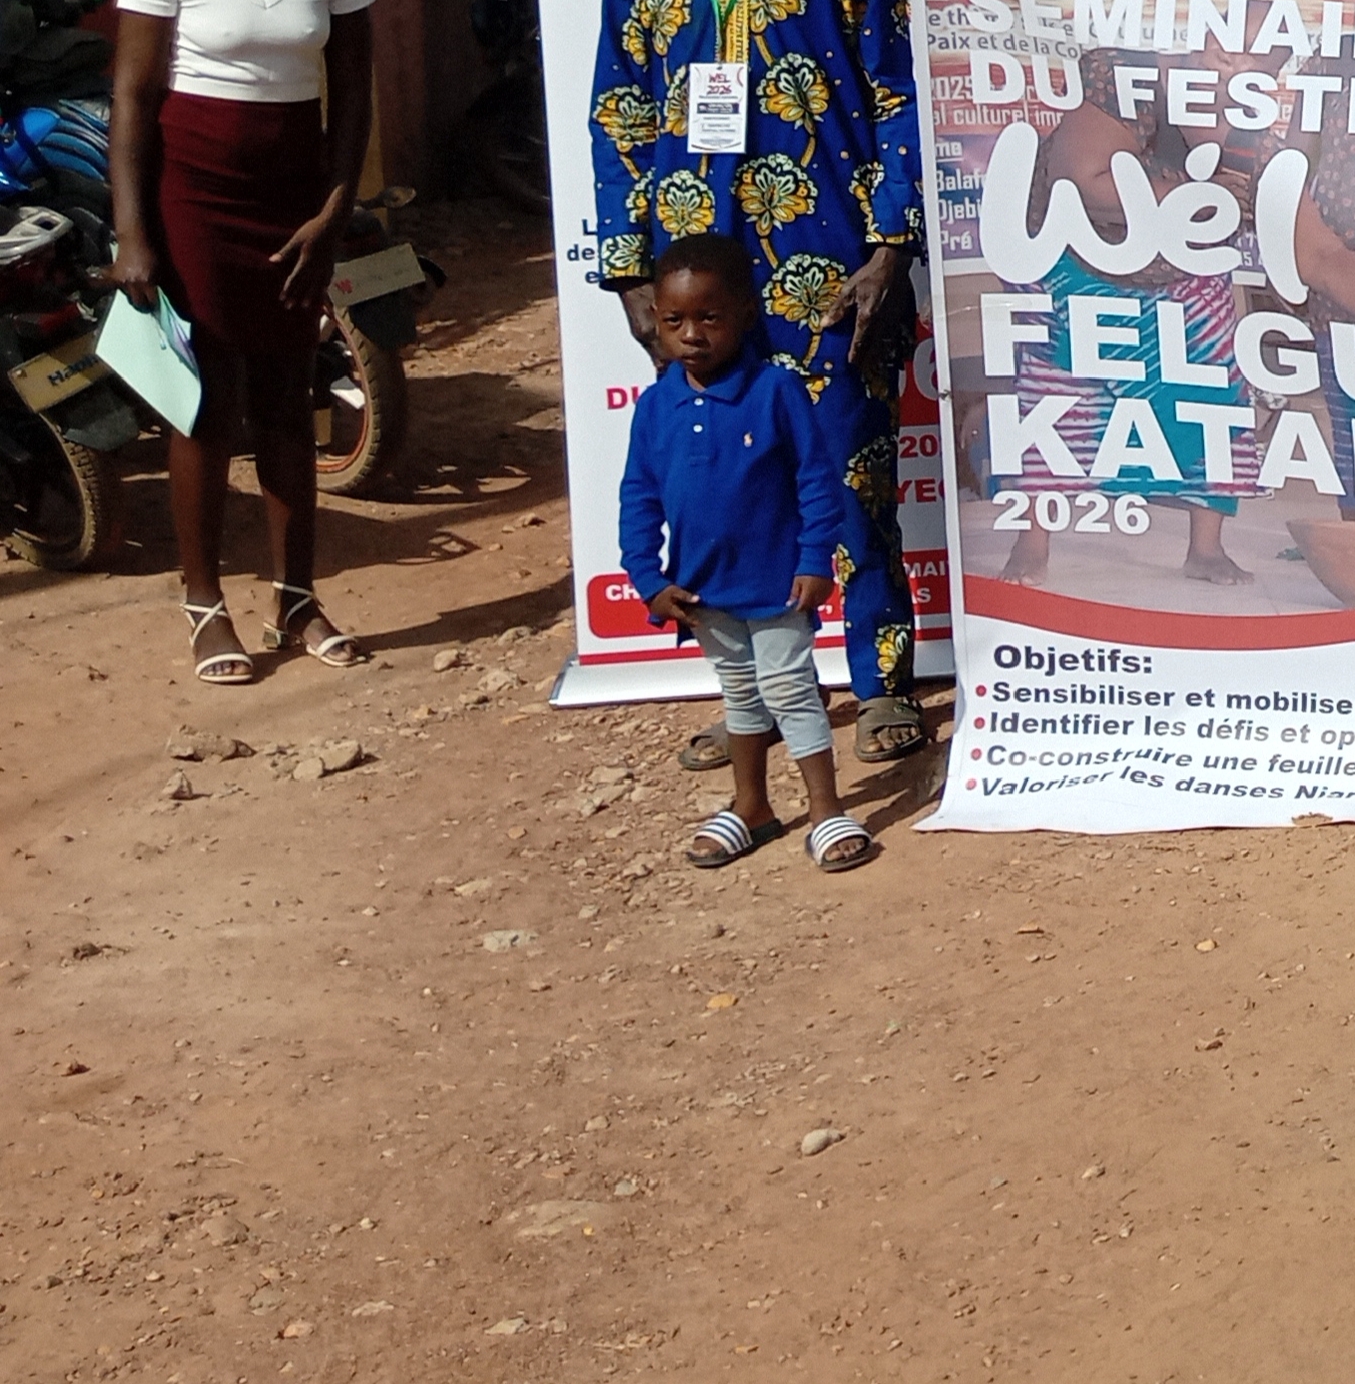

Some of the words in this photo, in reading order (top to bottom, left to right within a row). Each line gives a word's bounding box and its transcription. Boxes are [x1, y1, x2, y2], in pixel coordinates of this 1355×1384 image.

[970, 49, 1084, 111] DU
[991, 490, 1152, 534] 2026
[993, 644, 1153, 676] Objetifs:
[991, 681, 1176, 707] Sensibiliser
[1185, 688, 1216, 708] et
[989, 711, 1135, 736] Identifier
[1144, 715, 1187, 737] les
[1196, 716, 1270, 743] défis
[1280, 723, 1311, 744] et
[986, 744, 1193, 768] Co-construire
[1202, 755, 1258, 772] une
[980, 770, 1115, 797] Valoriser
[1119, 765, 1165, 788] les
[1174, 775, 1286, 800] danses
